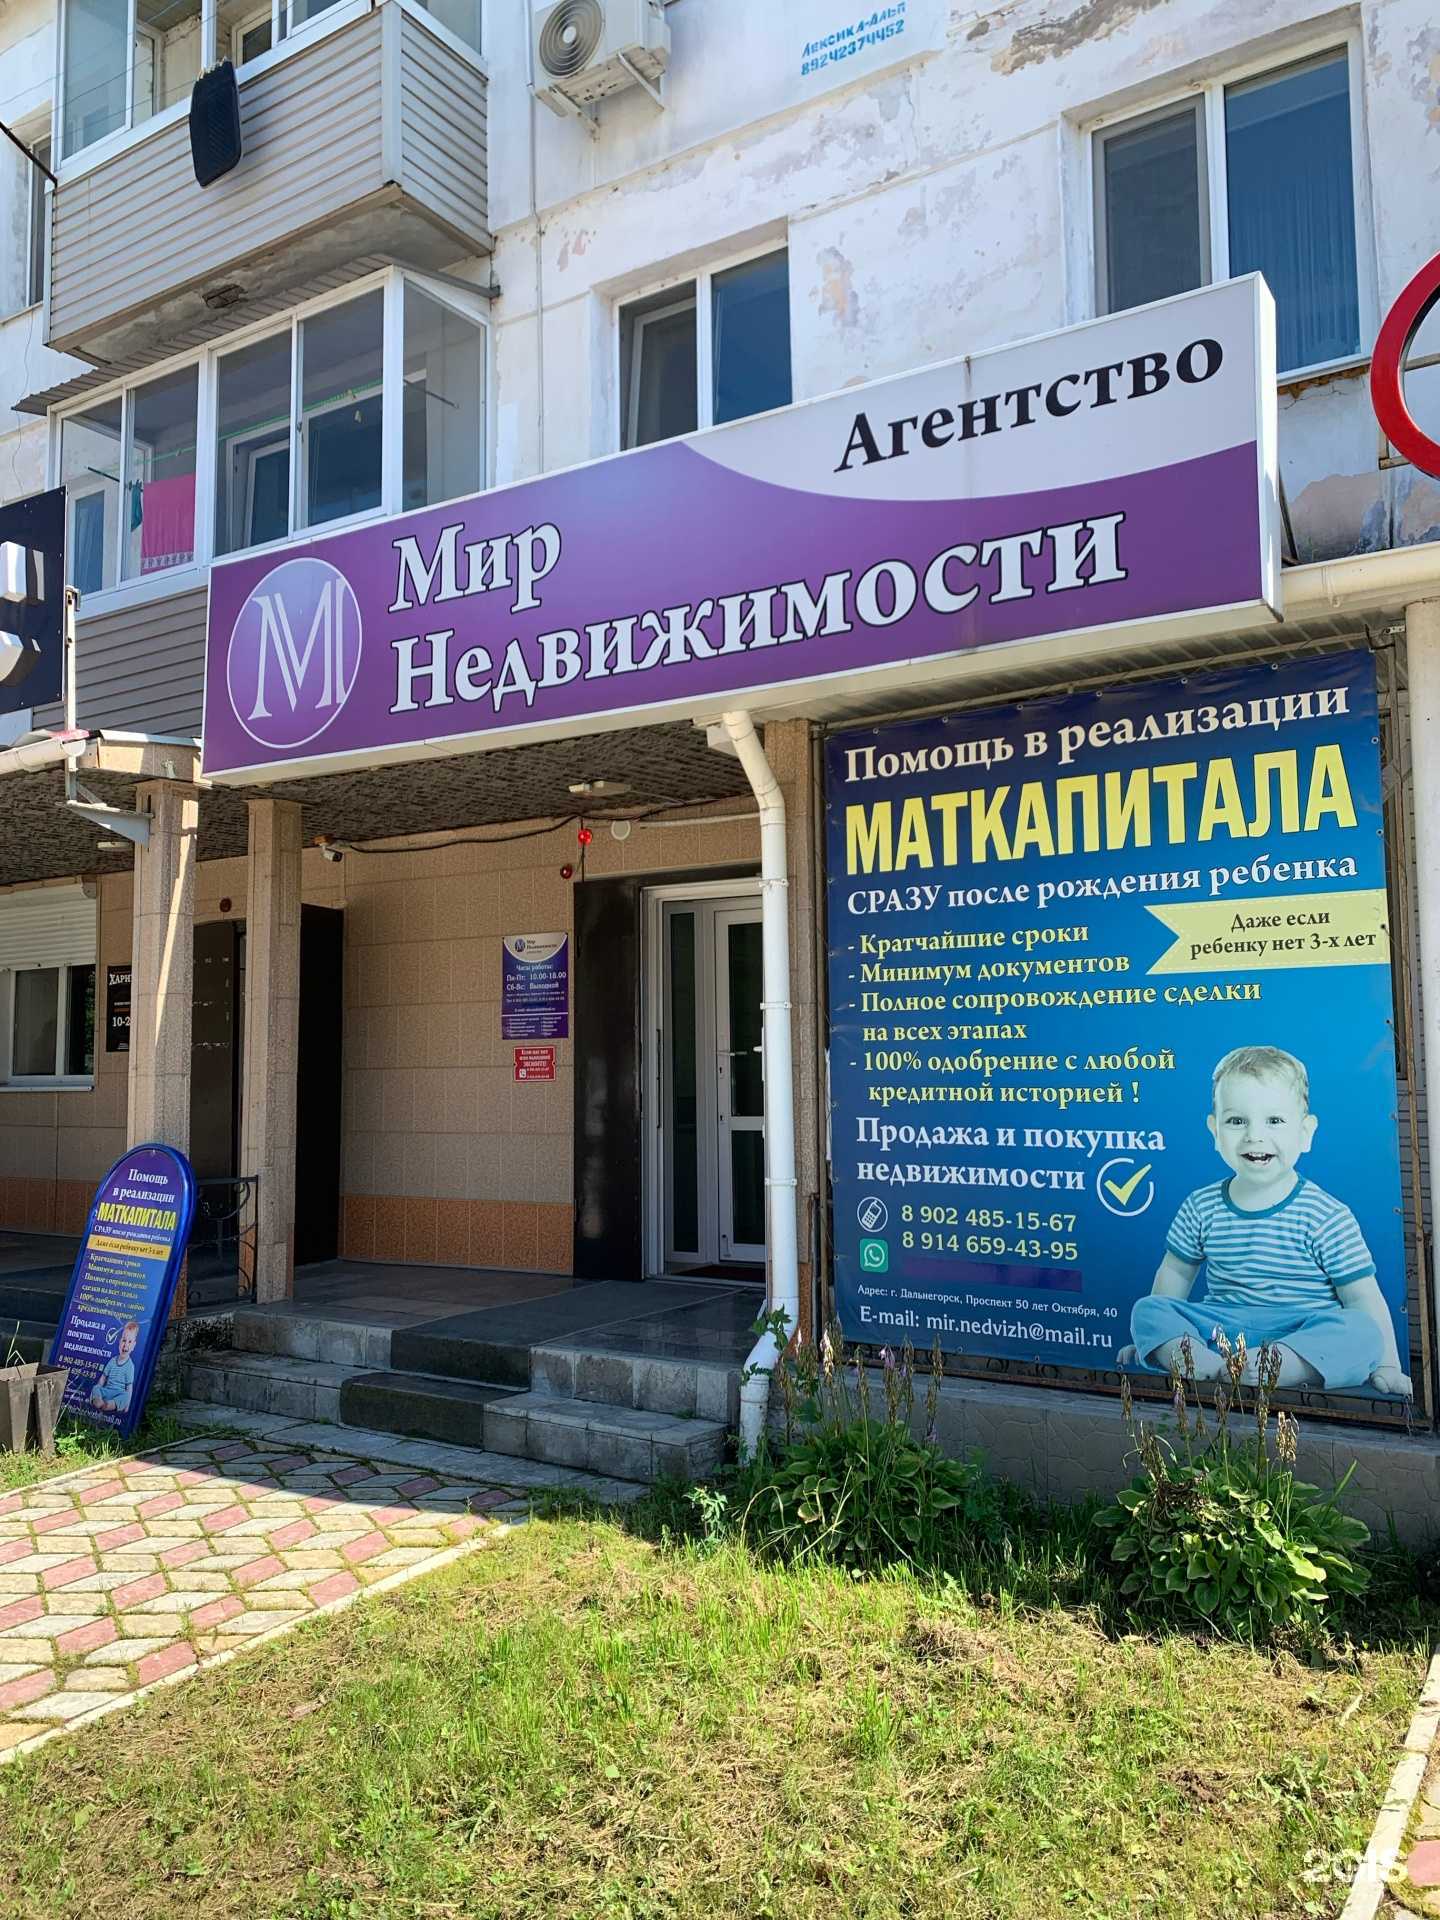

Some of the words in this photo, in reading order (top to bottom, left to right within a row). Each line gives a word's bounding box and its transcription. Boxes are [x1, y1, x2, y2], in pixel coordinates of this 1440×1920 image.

[801, 19, 905, 76] 89242374452
[833, 338, 1225, 473] Агентство
[388, 522, 562, 614] Мир
[389, 511, 1127, 714] Недвижимости
[844, 735, 1014, 783] Помощь
[1023, 730, 1048, 759] в
[1058, 686, 1350, 764] реализации
[846, 743, 1358, 875] МАТКАПИТАЛА
[847, 884, 944, 915] СРАЗУ
[947, 882, 1031, 906] после
[1038, 868, 1201, 913] рождения
[1208, 853, 1358, 896] ребенка
[1231, 913, 1282, 933] Даже
[1286, 911, 1330, 927] если
[860, 929, 1006, 960] Кратчайшие
[1011, 926, 1089, 952] сроки
[1190, 938, 1267, 960] ребенку
[1272, 936, 1305, 950] нет
[1310, 933, 1341, 950] 3-х
[1343, 933, 1376, 947] лет
[860, 962, 972, 985] Минимум
[977, 954, 1130, 984] документов
[861, 992, 947, 1013] Полное
[951, 987, 1157, 1015] сопровождение
[1164, 983, 1262, 1006] сделки
[863, 1026, 888, 1042] на
[893, 1024, 943, 1041] всех
[947, 1022, 1027, 1040] этапах
[864, 1051, 922, 1072] 100%
[927, 1048, 1058, 1077] одобрение
[1064, 1054, 1078, 1070] с
[1084, 1047, 1176, 1070] любой
[868, 1082, 994, 1107] кредитной
[1000, 1082, 1124, 1109] историей
[856, 1117, 989, 1151] Продажа
[996, 1127, 1017, 1147] и
[1023, 1127, 1167, 1158] покупка
[127, 1168, 169, 1186] Помощь
[857, 1161, 1086, 1191] недвижимости
[112, 1187, 120, 1196] в
[118, 1188, 175, 1204] реализации
[97, 1202, 177, 1231] МАТКАПИТАЛА
[901, 1205, 914, 1222] 8
[920, 1206, 959, 1225] 902
[965, 1209, 1077, 1232] 485-15-67
[902, 1231, 914, 1249] 8
[920, 1233, 960, 1252] 914
[966, 1236, 1078, 1261] 659-43-95
[857, 1284, 888, 1298] Адрес:
[890, 1289, 898, 1297] г.
[900, 1289, 963, 1305] Дальнегорск,
[966, 1294, 1013, 1310] Проспект
[1015, 1299, 1029, 1310] 50
[1031, 1301, 1049, 1312] лет
[1051, 1301, 1100, 1317] Октября,
[1103, 1306, 1118, 1318] 40
[860, 1306, 920, 1328] E-mail:
[926, 1313, 1112, 1348] mir.nedvizh@mail.ru
[63, 1341, 112, 1358] недвижимости
